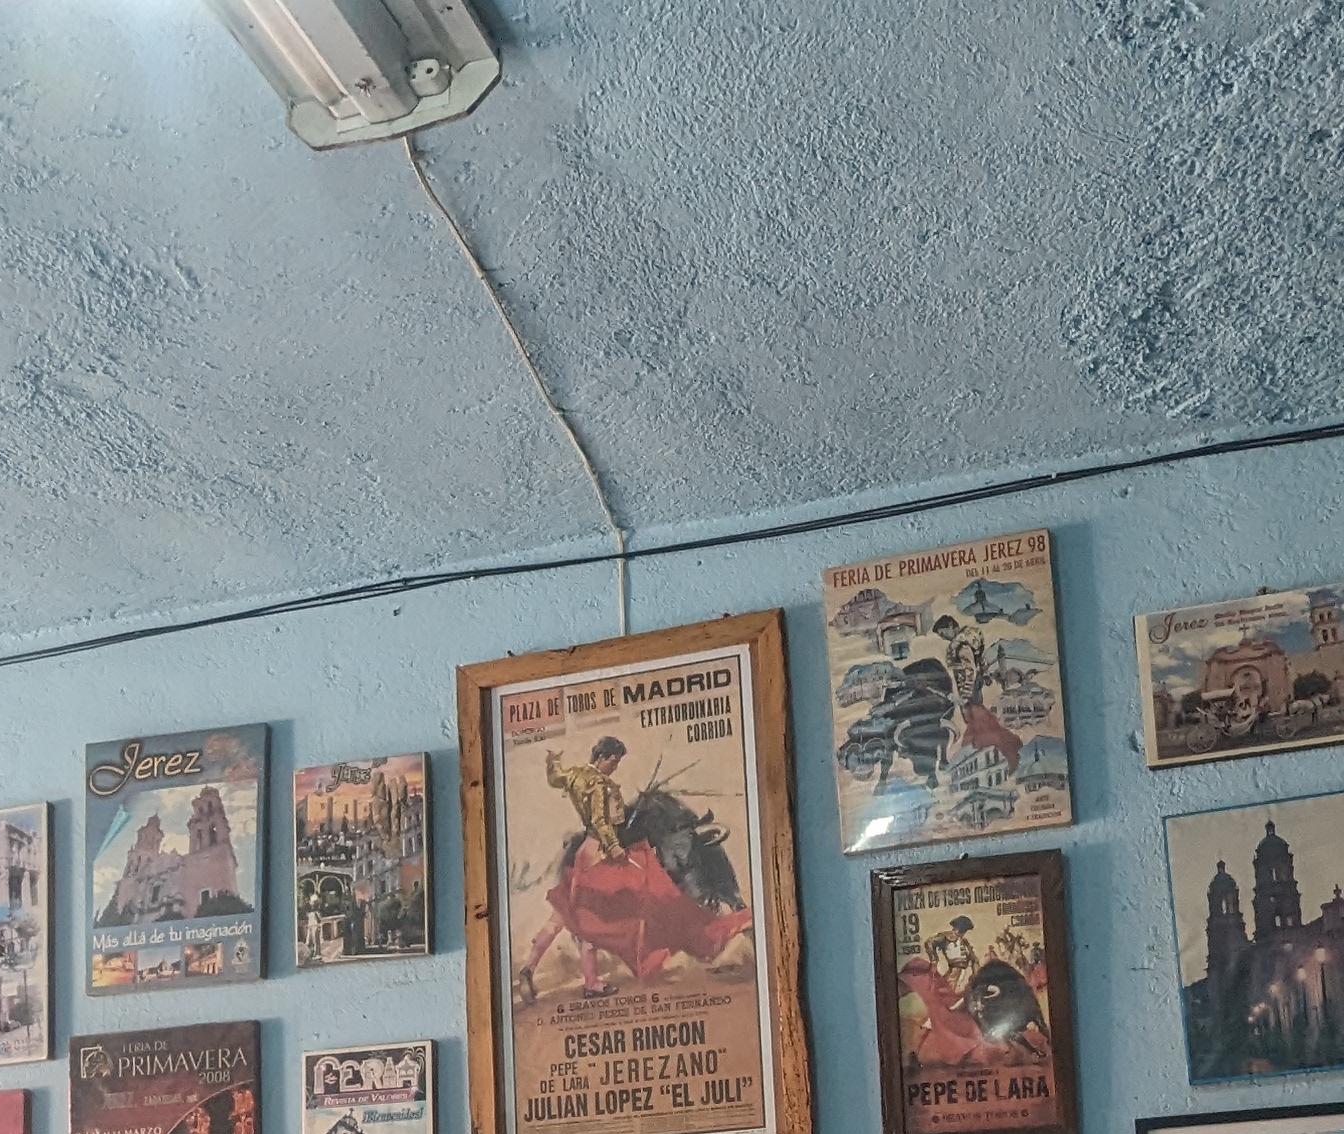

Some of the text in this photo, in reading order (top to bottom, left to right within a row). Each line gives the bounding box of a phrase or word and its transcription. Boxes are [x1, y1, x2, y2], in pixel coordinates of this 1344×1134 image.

[833, 535, 1046, 589] FERIA DE PRIMAVERA JEREZ 98
[1148, 611, 1209, 645] Jerez
[509, 668, 732, 723] PLAZA DE TOROS DE MADRID
[640, 695, 732, 729] EXTRAORDINARIA
[687, 718, 733, 744] CORRIDA
[89, 742, 201, 796] Jerez
[92, 920, 253, 952] Más allá de tu imaginación
[900, 913, 921, 935] 19
[569, 999, 612, 1012] BRAVOS
[651, 993, 660, 1004] 6
[676, 995, 732, 1011] FERNANDO
[564, 1030, 626, 1059] CESAR
[633, 1020, 706, 1051] RINCON
[118, 1047, 248, 1078] PRIMAVERA
[198, 1070, 231, 1085] 2008
[314, 1051, 419, 1094] FERIA
[550, 1061, 578, 1078] PEPE
[540, 1075, 590, 1094] DE LARA
[908, 1075, 1050, 1106] PEPE DE LARA
[524, 1092, 589, 1123] JULIAN
[595, 1086, 654, 1116] LOPEZ
